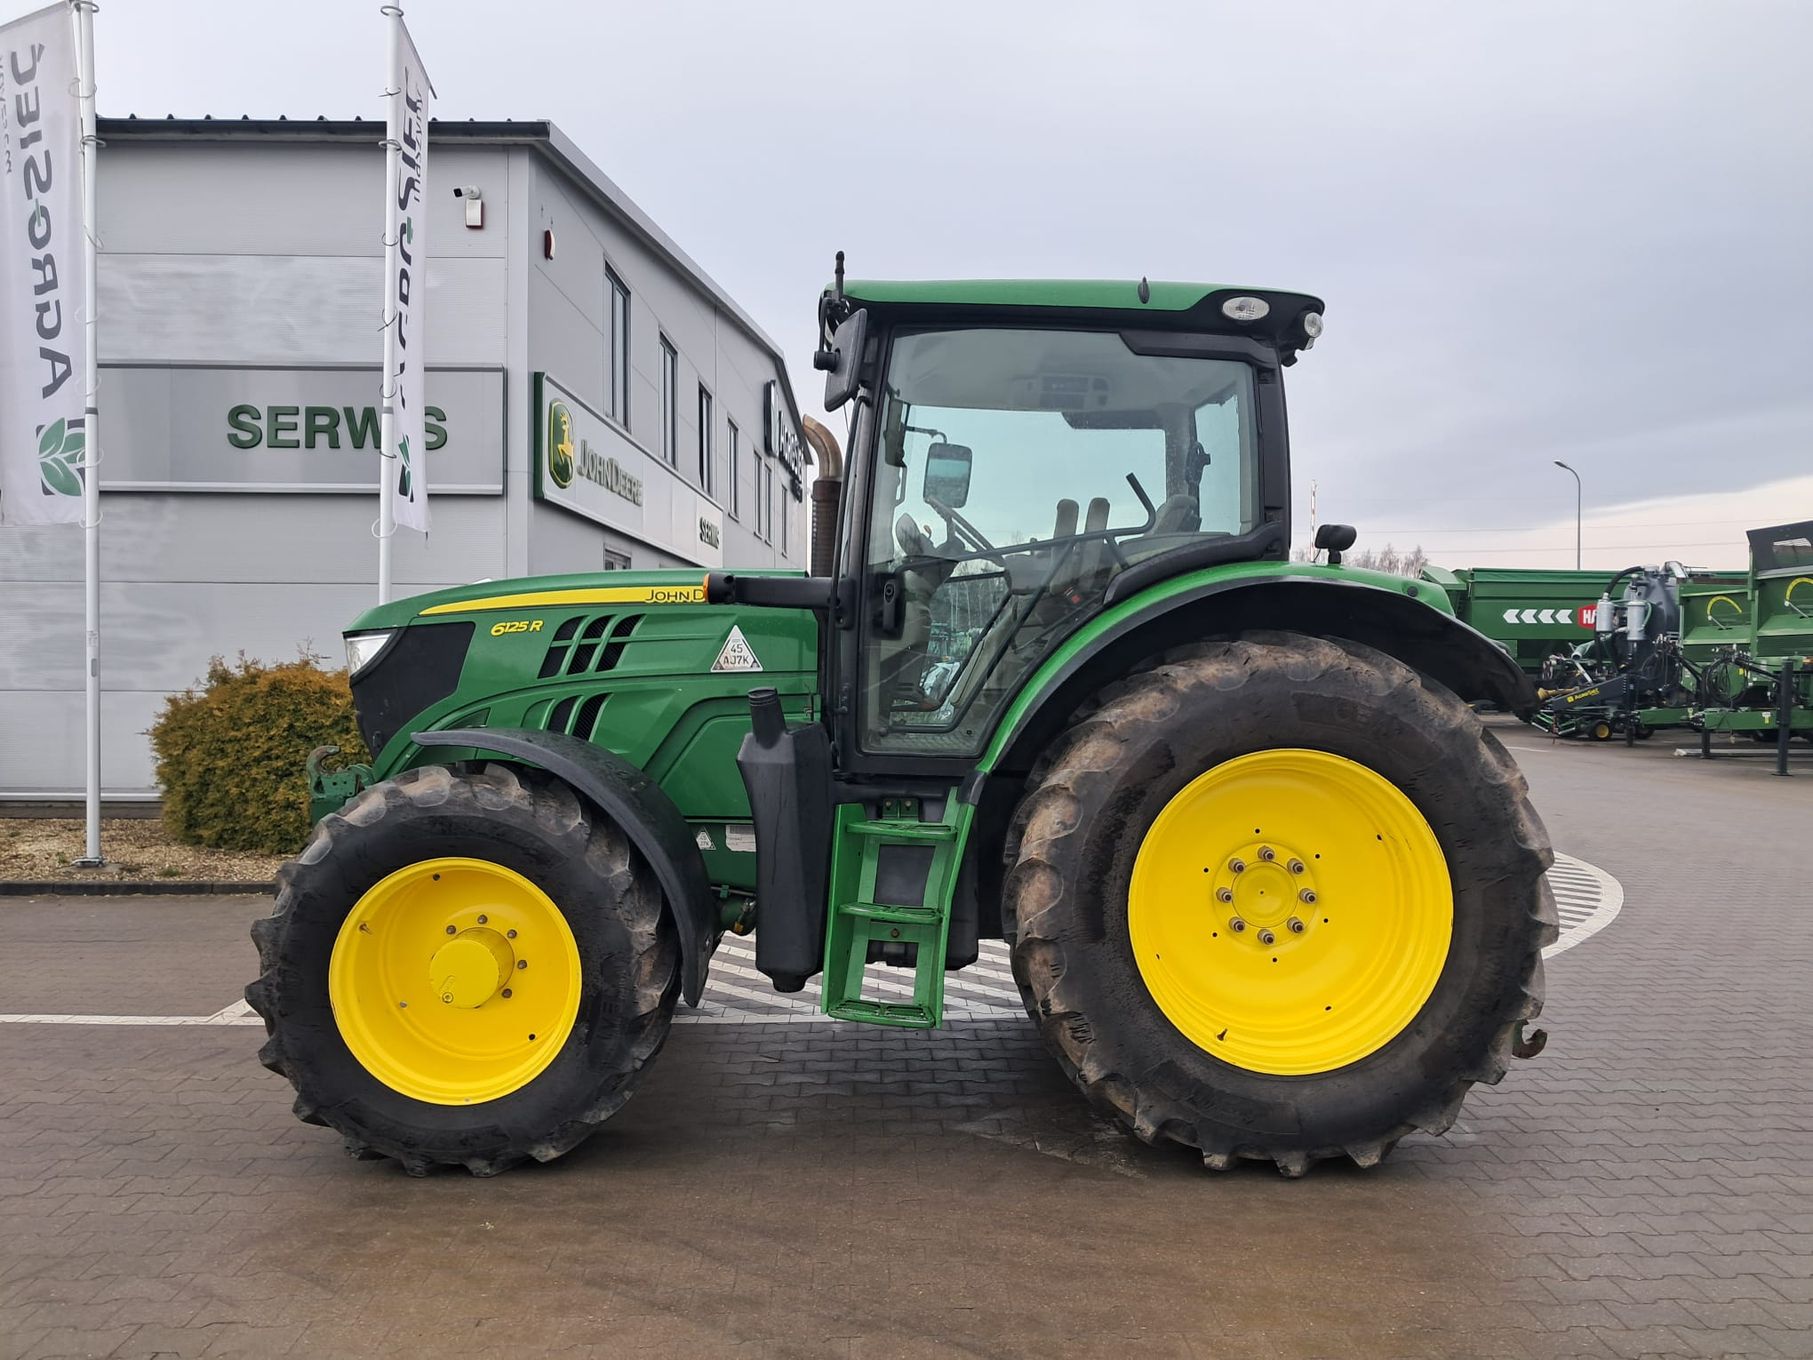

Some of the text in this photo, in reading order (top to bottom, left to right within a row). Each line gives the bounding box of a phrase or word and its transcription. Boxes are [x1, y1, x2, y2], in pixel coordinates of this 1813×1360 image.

[227, 404, 448, 450] SERWS
[577, 439, 613, 492] JOHN
[646, 588, 690, 602] JOHN
[730, 643, 743, 654] 45
